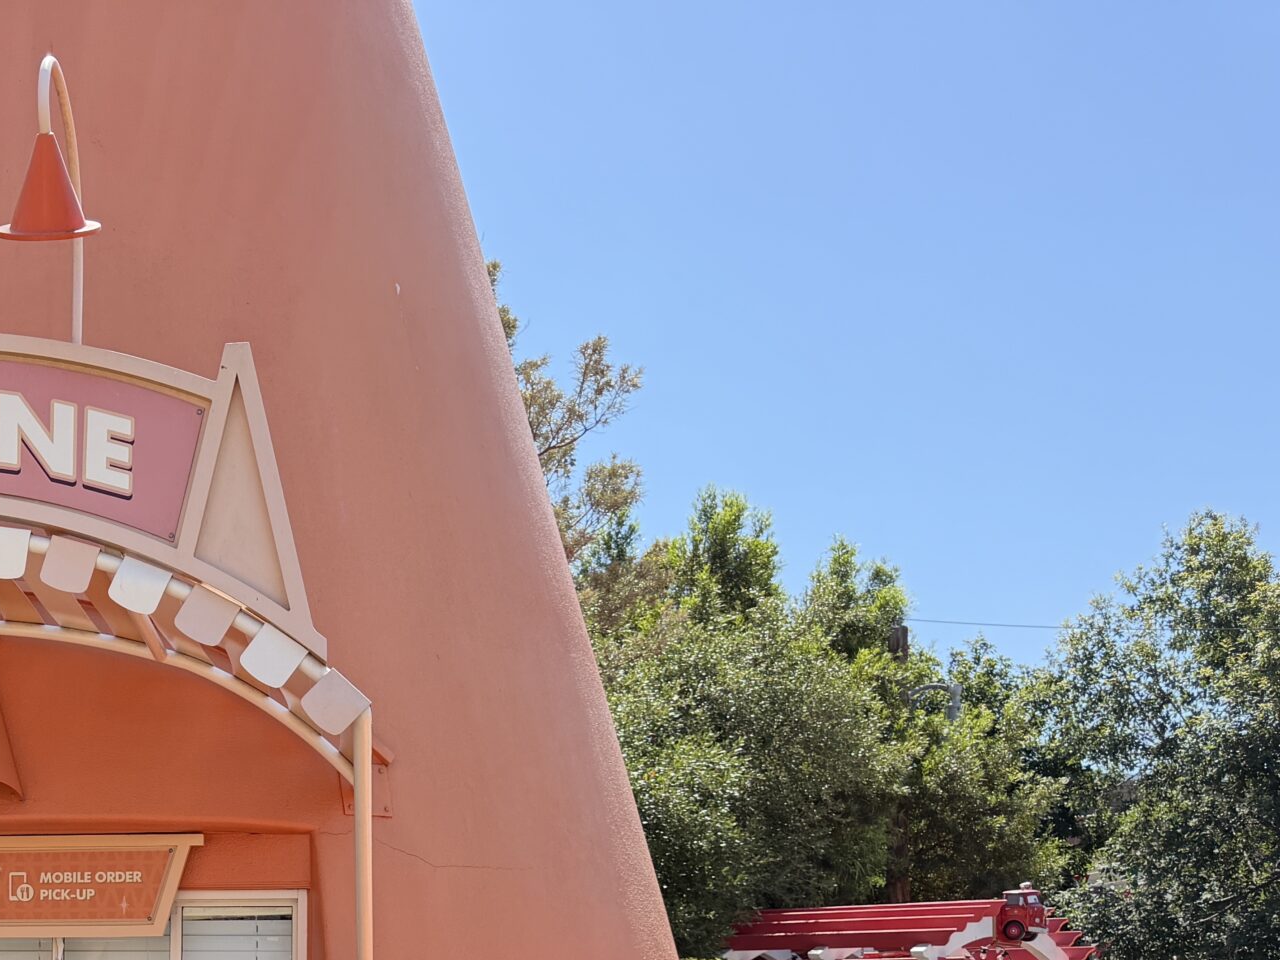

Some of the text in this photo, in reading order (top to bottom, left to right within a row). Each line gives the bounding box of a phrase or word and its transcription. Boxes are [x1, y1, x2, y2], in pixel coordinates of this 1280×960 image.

[39, 871, 142, 884] MOBILE ORDER
[40, 888, 95, 900] PICK-UP
